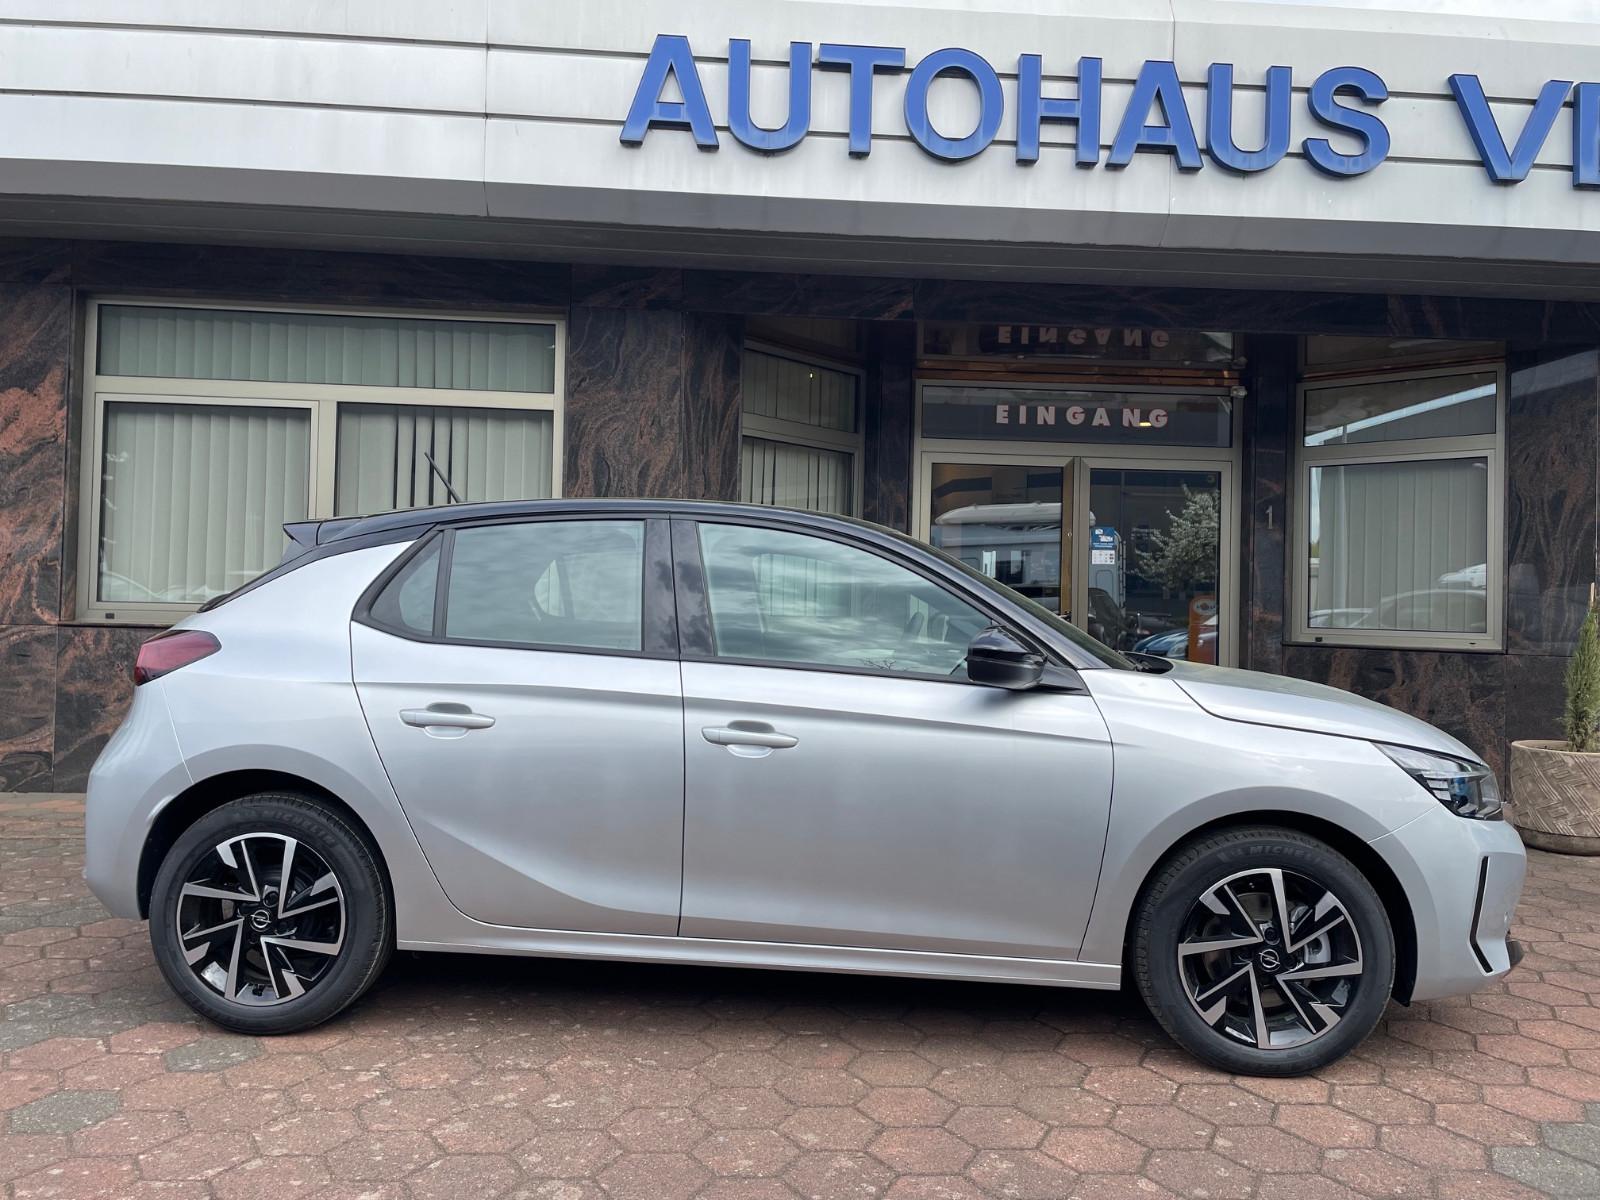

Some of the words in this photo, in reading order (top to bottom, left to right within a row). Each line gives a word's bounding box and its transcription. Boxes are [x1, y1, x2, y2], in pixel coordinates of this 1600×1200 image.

[619, 34, 1391, 177] AUTOHAUS
[1448, 73, 1600, 190] V
[996, 404, 1168, 428] EINGANG
[1265, 505, 1273, 530] 1
